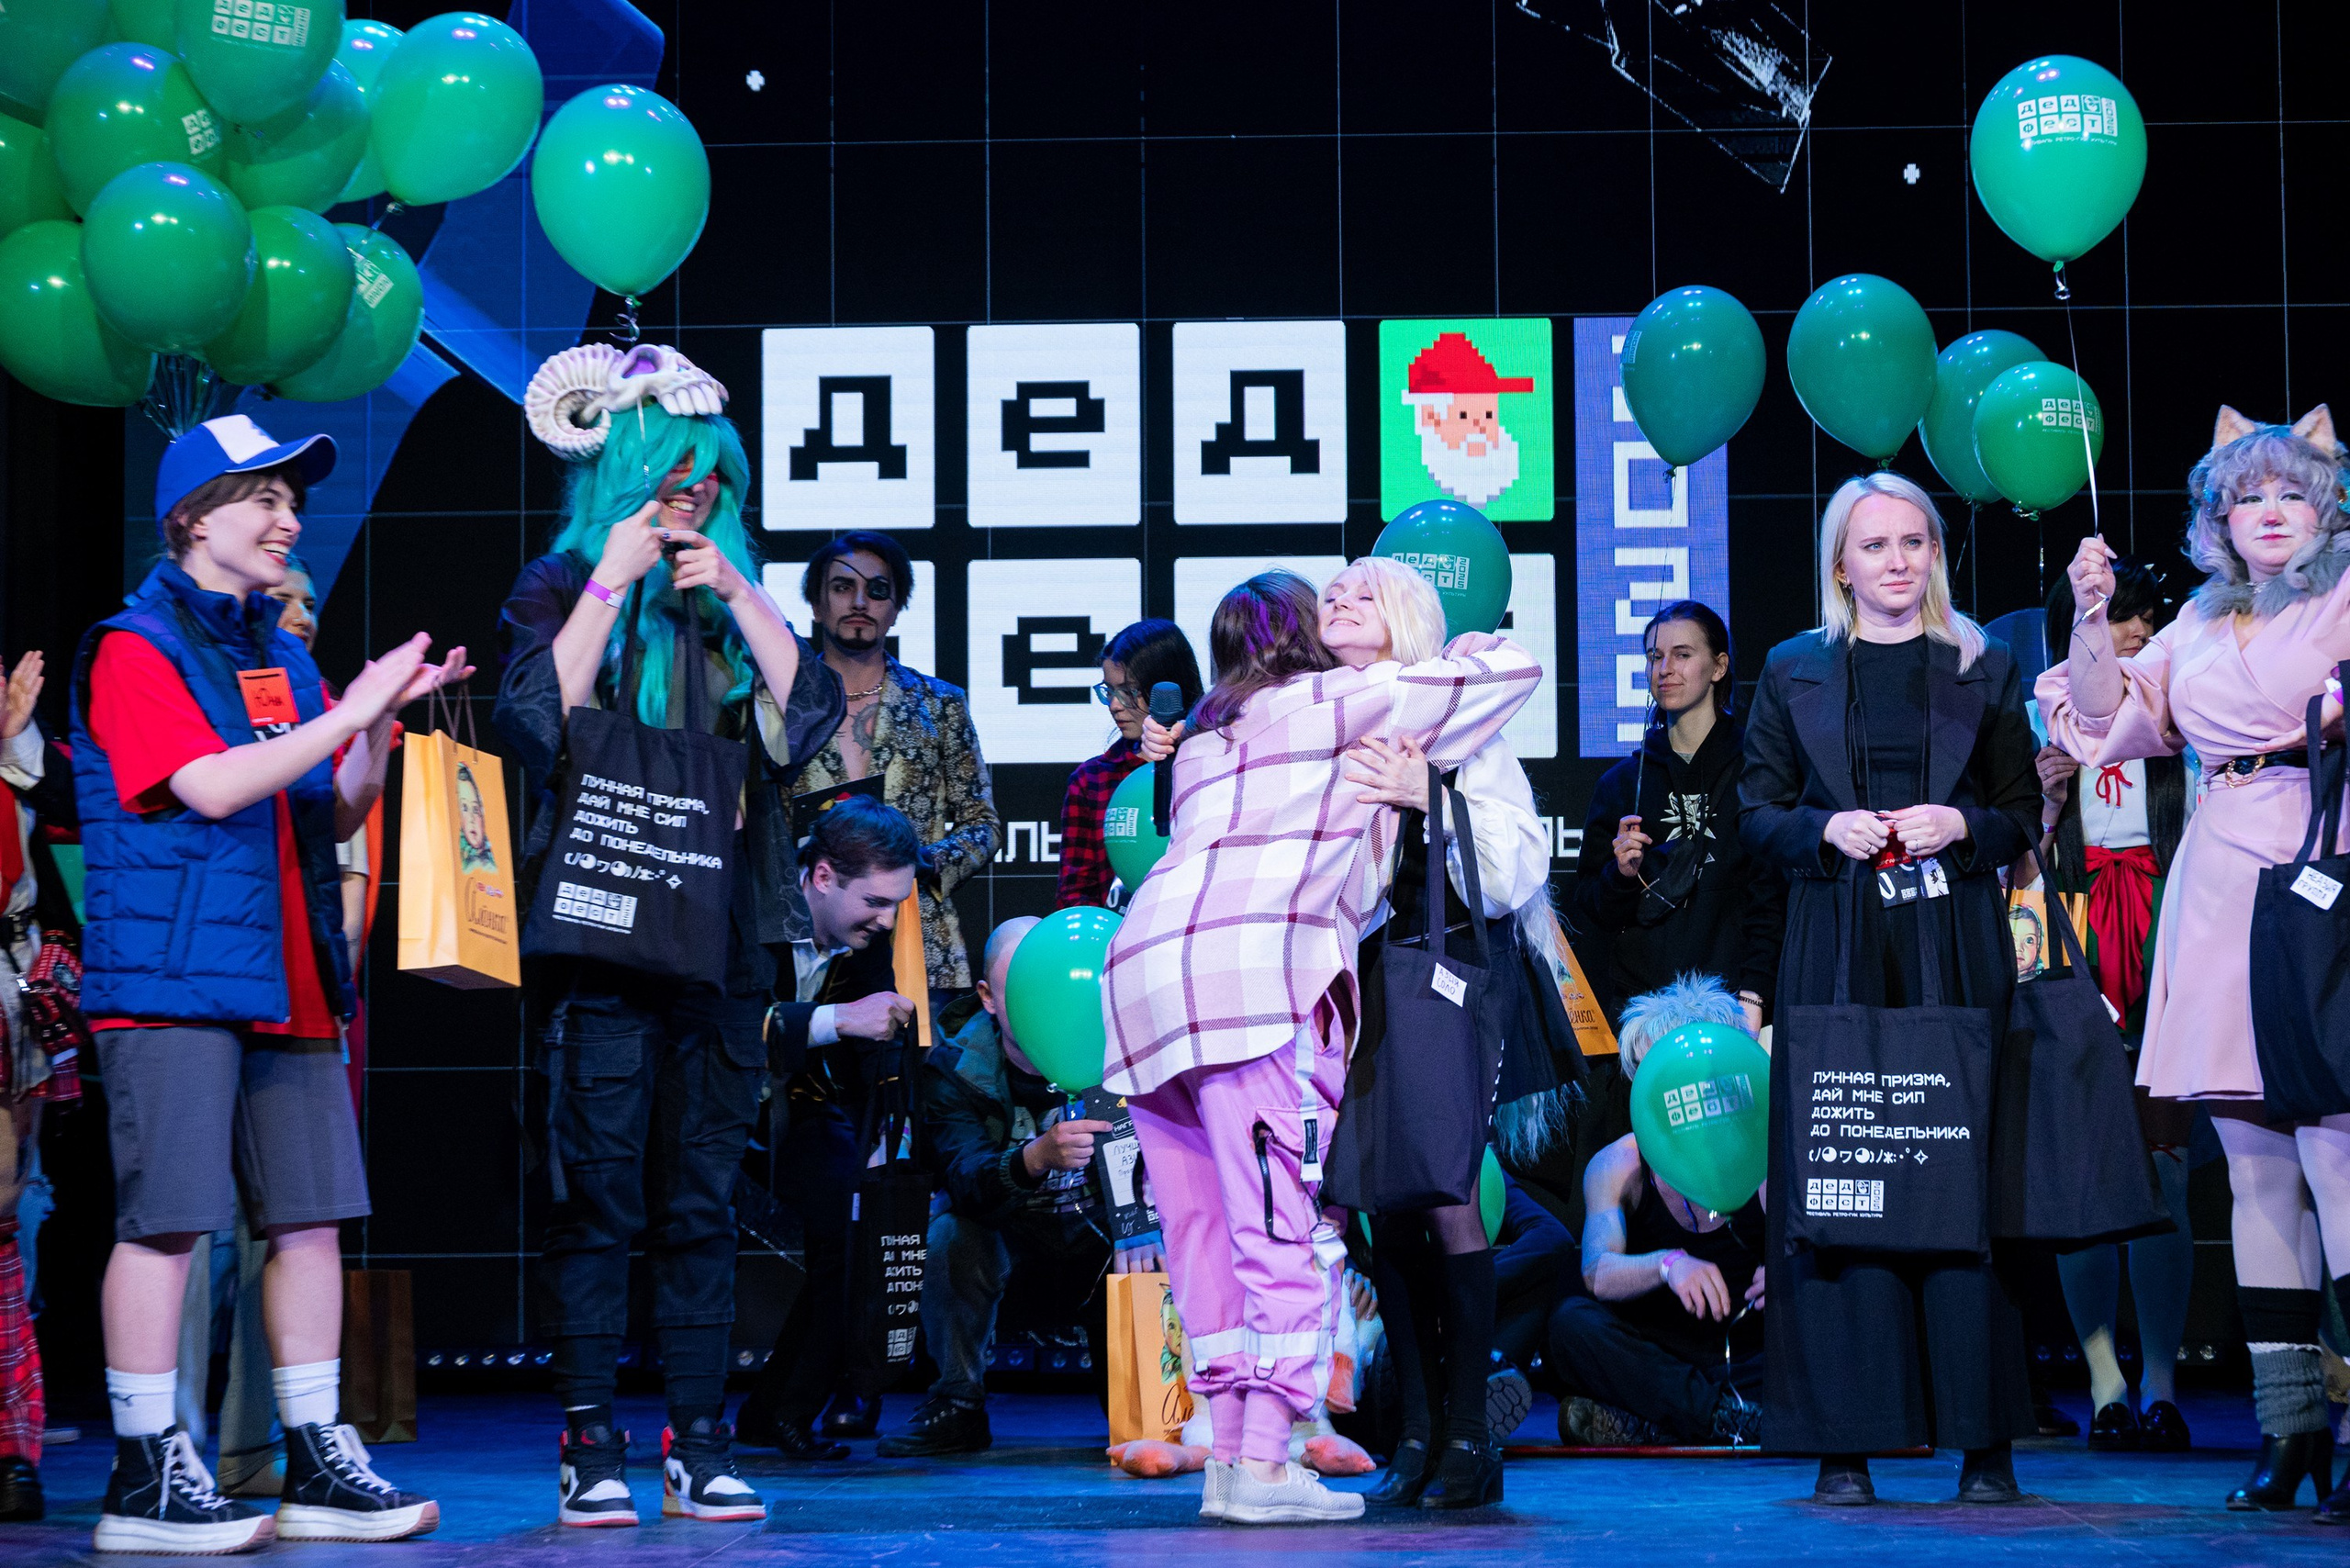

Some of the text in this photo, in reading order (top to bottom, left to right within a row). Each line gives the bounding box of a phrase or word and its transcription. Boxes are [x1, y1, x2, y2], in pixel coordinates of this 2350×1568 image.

[1458, 556, 1467, 588] 2025
[581, 774, 645, 799] ЛУННАЯ
[577, 792, 687, 827] ДАЙ МНЕ СИЛ
[573, 810, 639, 834] ДОЖИТЬ
[569, 827, 722, 869] ДО ПОНЕДЕЛЬНИКА
[1812, 1071, 1952, 1088] ЛУННАЯ ПРИЗМА,
[1812, 1088, 1925, 1104] ДАЙ МНЕ СИЛ
[1811, 1106, 1875, 1120] ДОЖИТЬ
[1810, 1124, 1970, 1139] ДО ПОНЕДЕЛЬНИКА
[1810, 1197, 1865, 1207] фест
